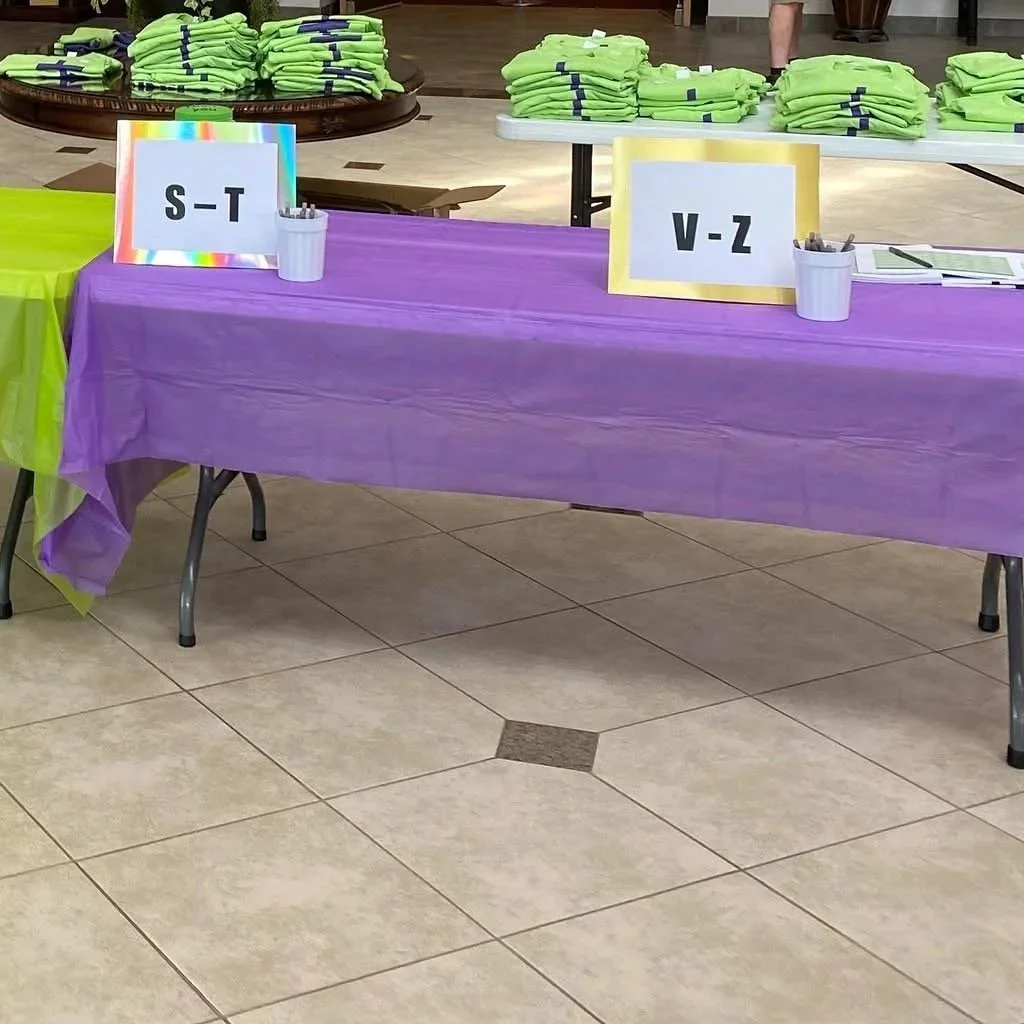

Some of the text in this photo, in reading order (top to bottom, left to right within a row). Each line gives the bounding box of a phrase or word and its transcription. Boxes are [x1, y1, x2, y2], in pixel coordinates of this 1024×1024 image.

[165, 184, 185, 220] S
[224, 187, 245, 222] T
[672, 213, 699, 251] V
[731, 215, 752, 254] Z
